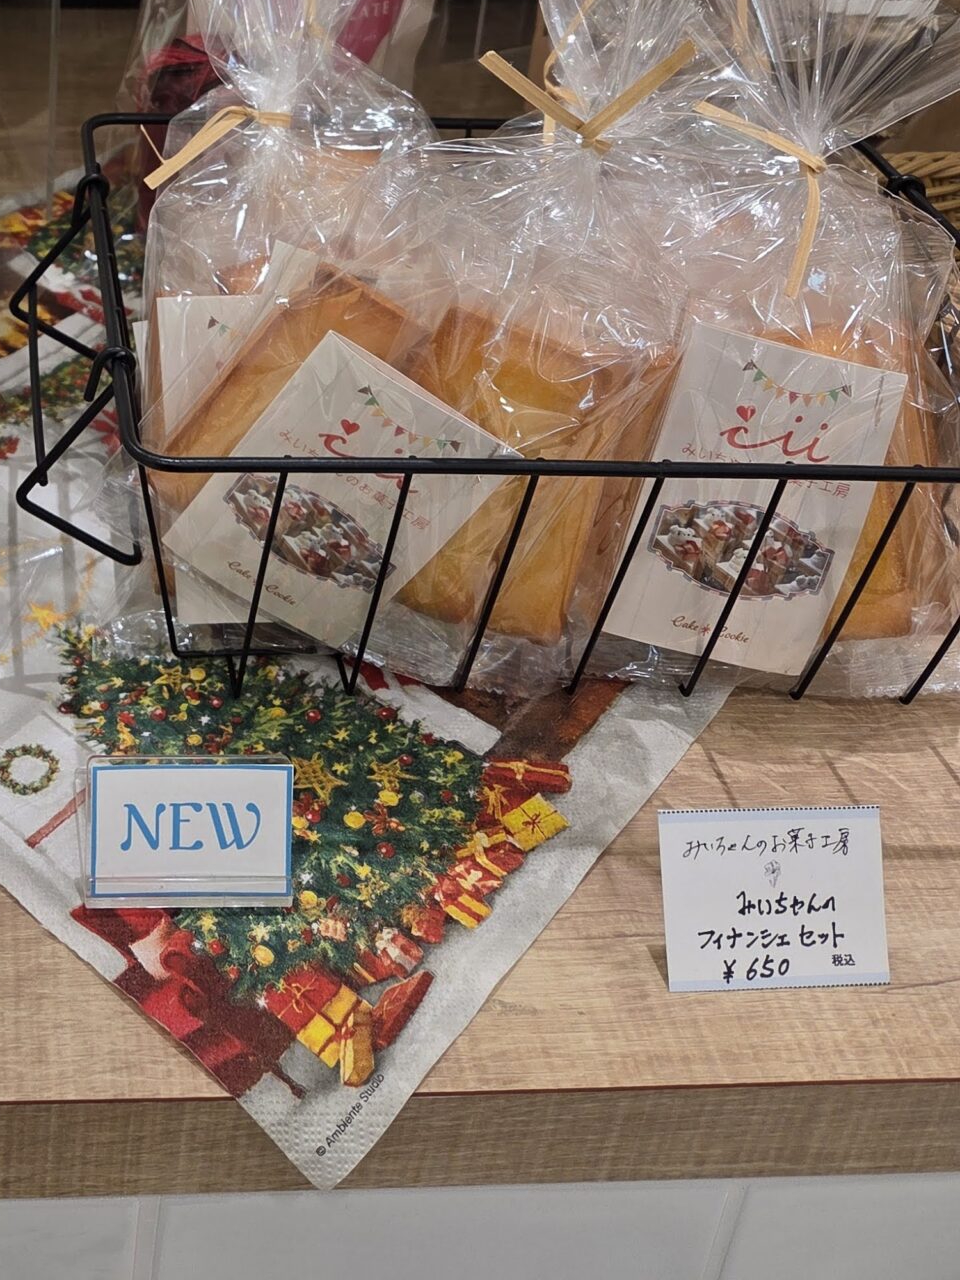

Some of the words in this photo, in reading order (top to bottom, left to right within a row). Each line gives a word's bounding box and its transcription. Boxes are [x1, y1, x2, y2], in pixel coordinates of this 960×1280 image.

[672, 615, 699, 631] Cake
[120, 802, 262, 851] NEW
[832, 954, 856, 967] 税込
[325, 1102, 364, 1148] Ambiente
